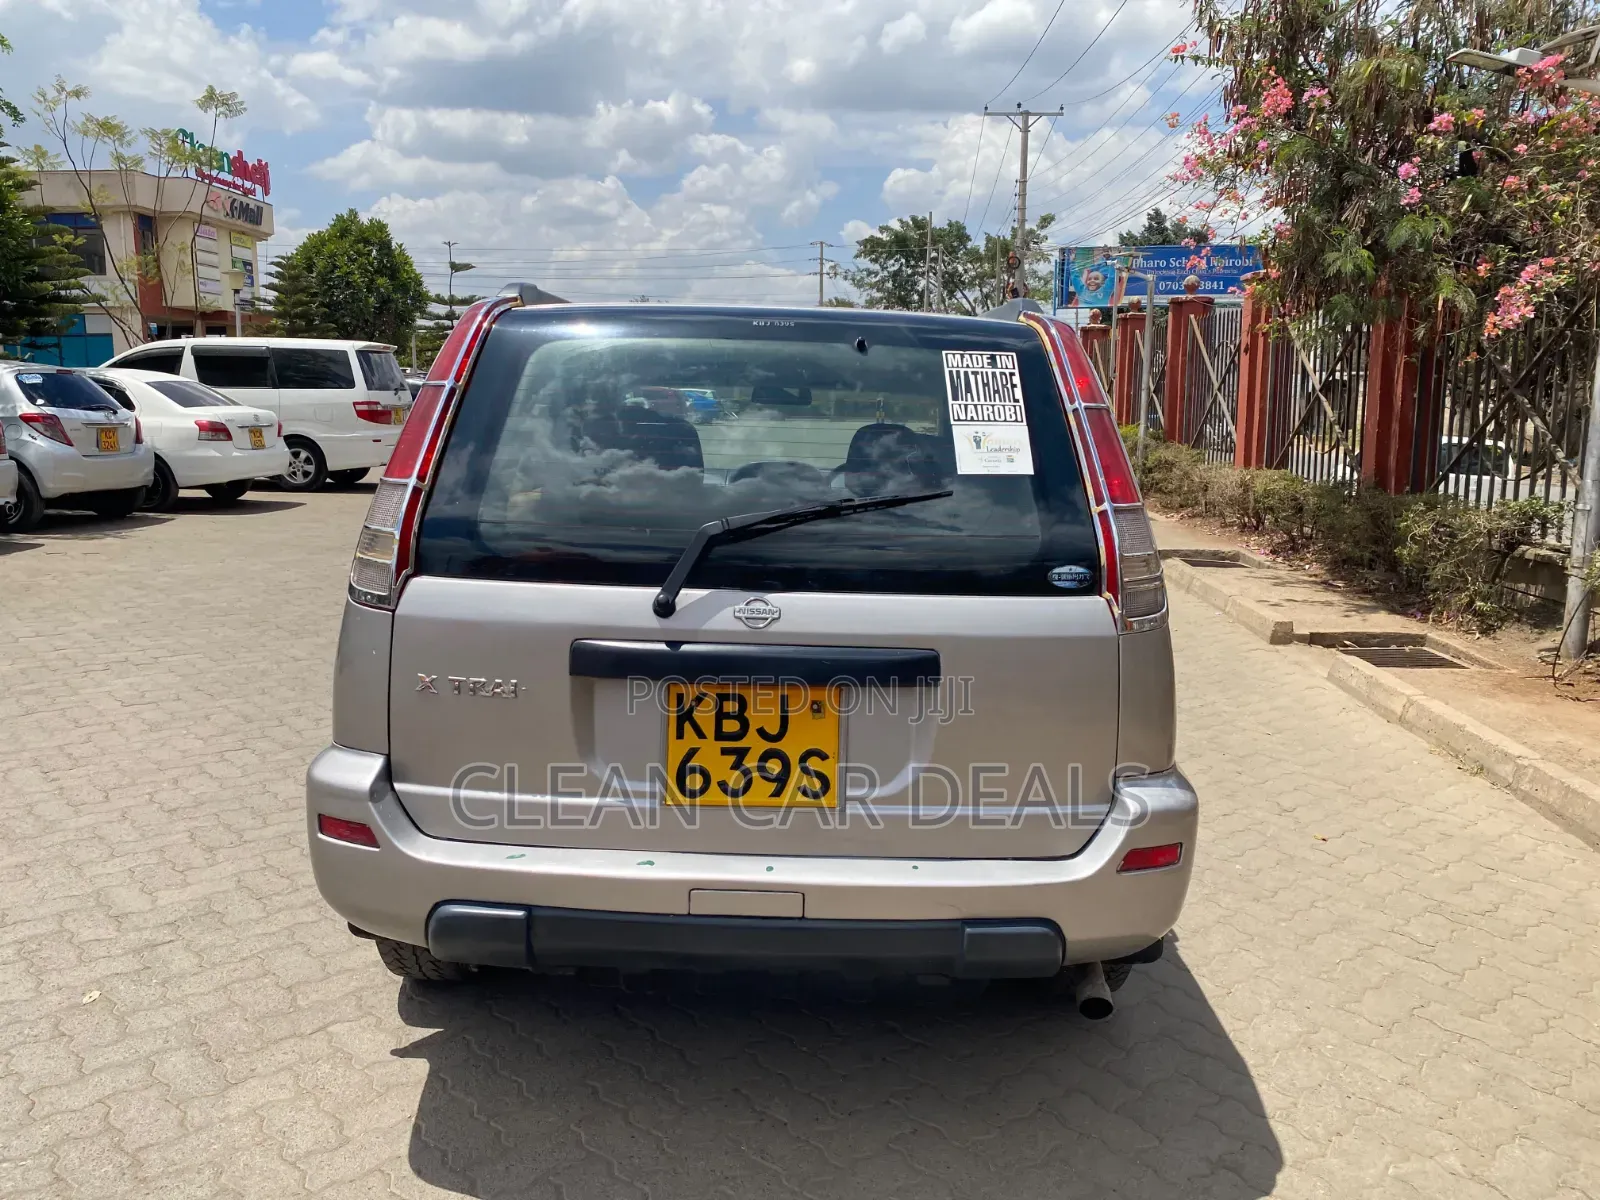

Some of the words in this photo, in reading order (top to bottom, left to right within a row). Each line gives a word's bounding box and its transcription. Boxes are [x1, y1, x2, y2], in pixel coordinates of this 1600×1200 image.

[1169, 256, 1208, 268] Schl
[1159, 280, 1225, 291] 07033841
[946, 353, 992, 369] MADE
[996, 355, 1015, 369] IN
[948, 369, 1021, 403] MATHARE
[952, 404, 1023, 422] NAIROBI
[738, 607, 775, 616] NISSAN
[415, 673, 438, 694] X
[447, 675, 526, 698] TRAI
[675, 692, 790, 744] KBJ
[675, 746, 831, 800] 639S
